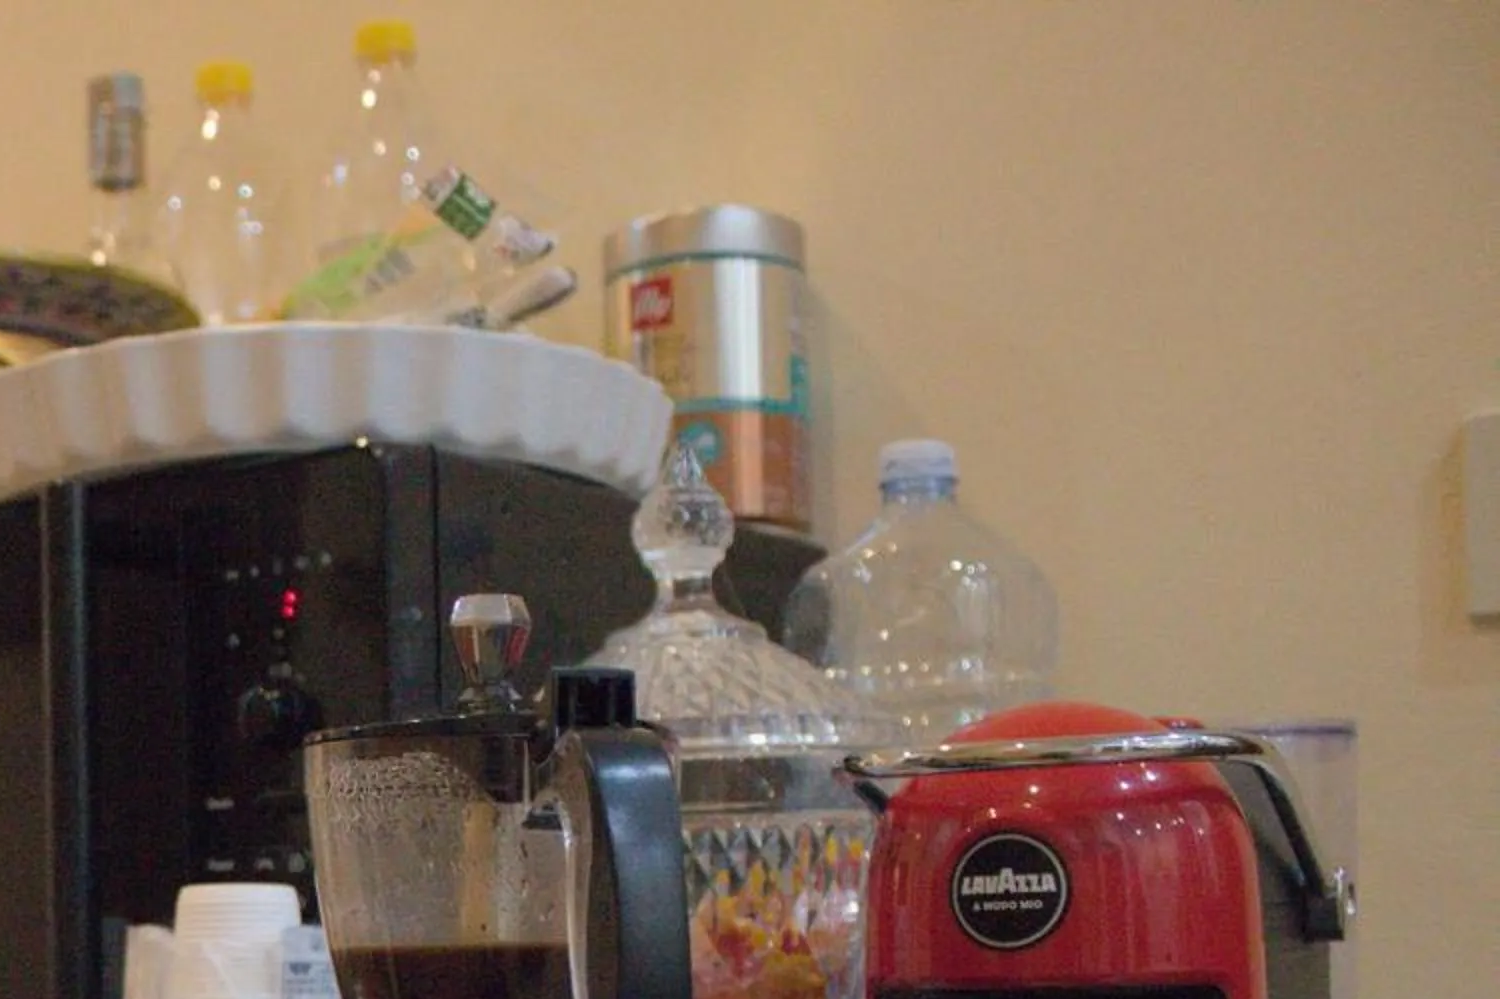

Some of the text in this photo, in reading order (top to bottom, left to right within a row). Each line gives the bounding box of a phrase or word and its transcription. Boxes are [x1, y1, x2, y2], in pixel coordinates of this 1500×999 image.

[961, 868, 1057, 896] LAVAZZA
[973, 899, 1044, 911] A MODO MIO
